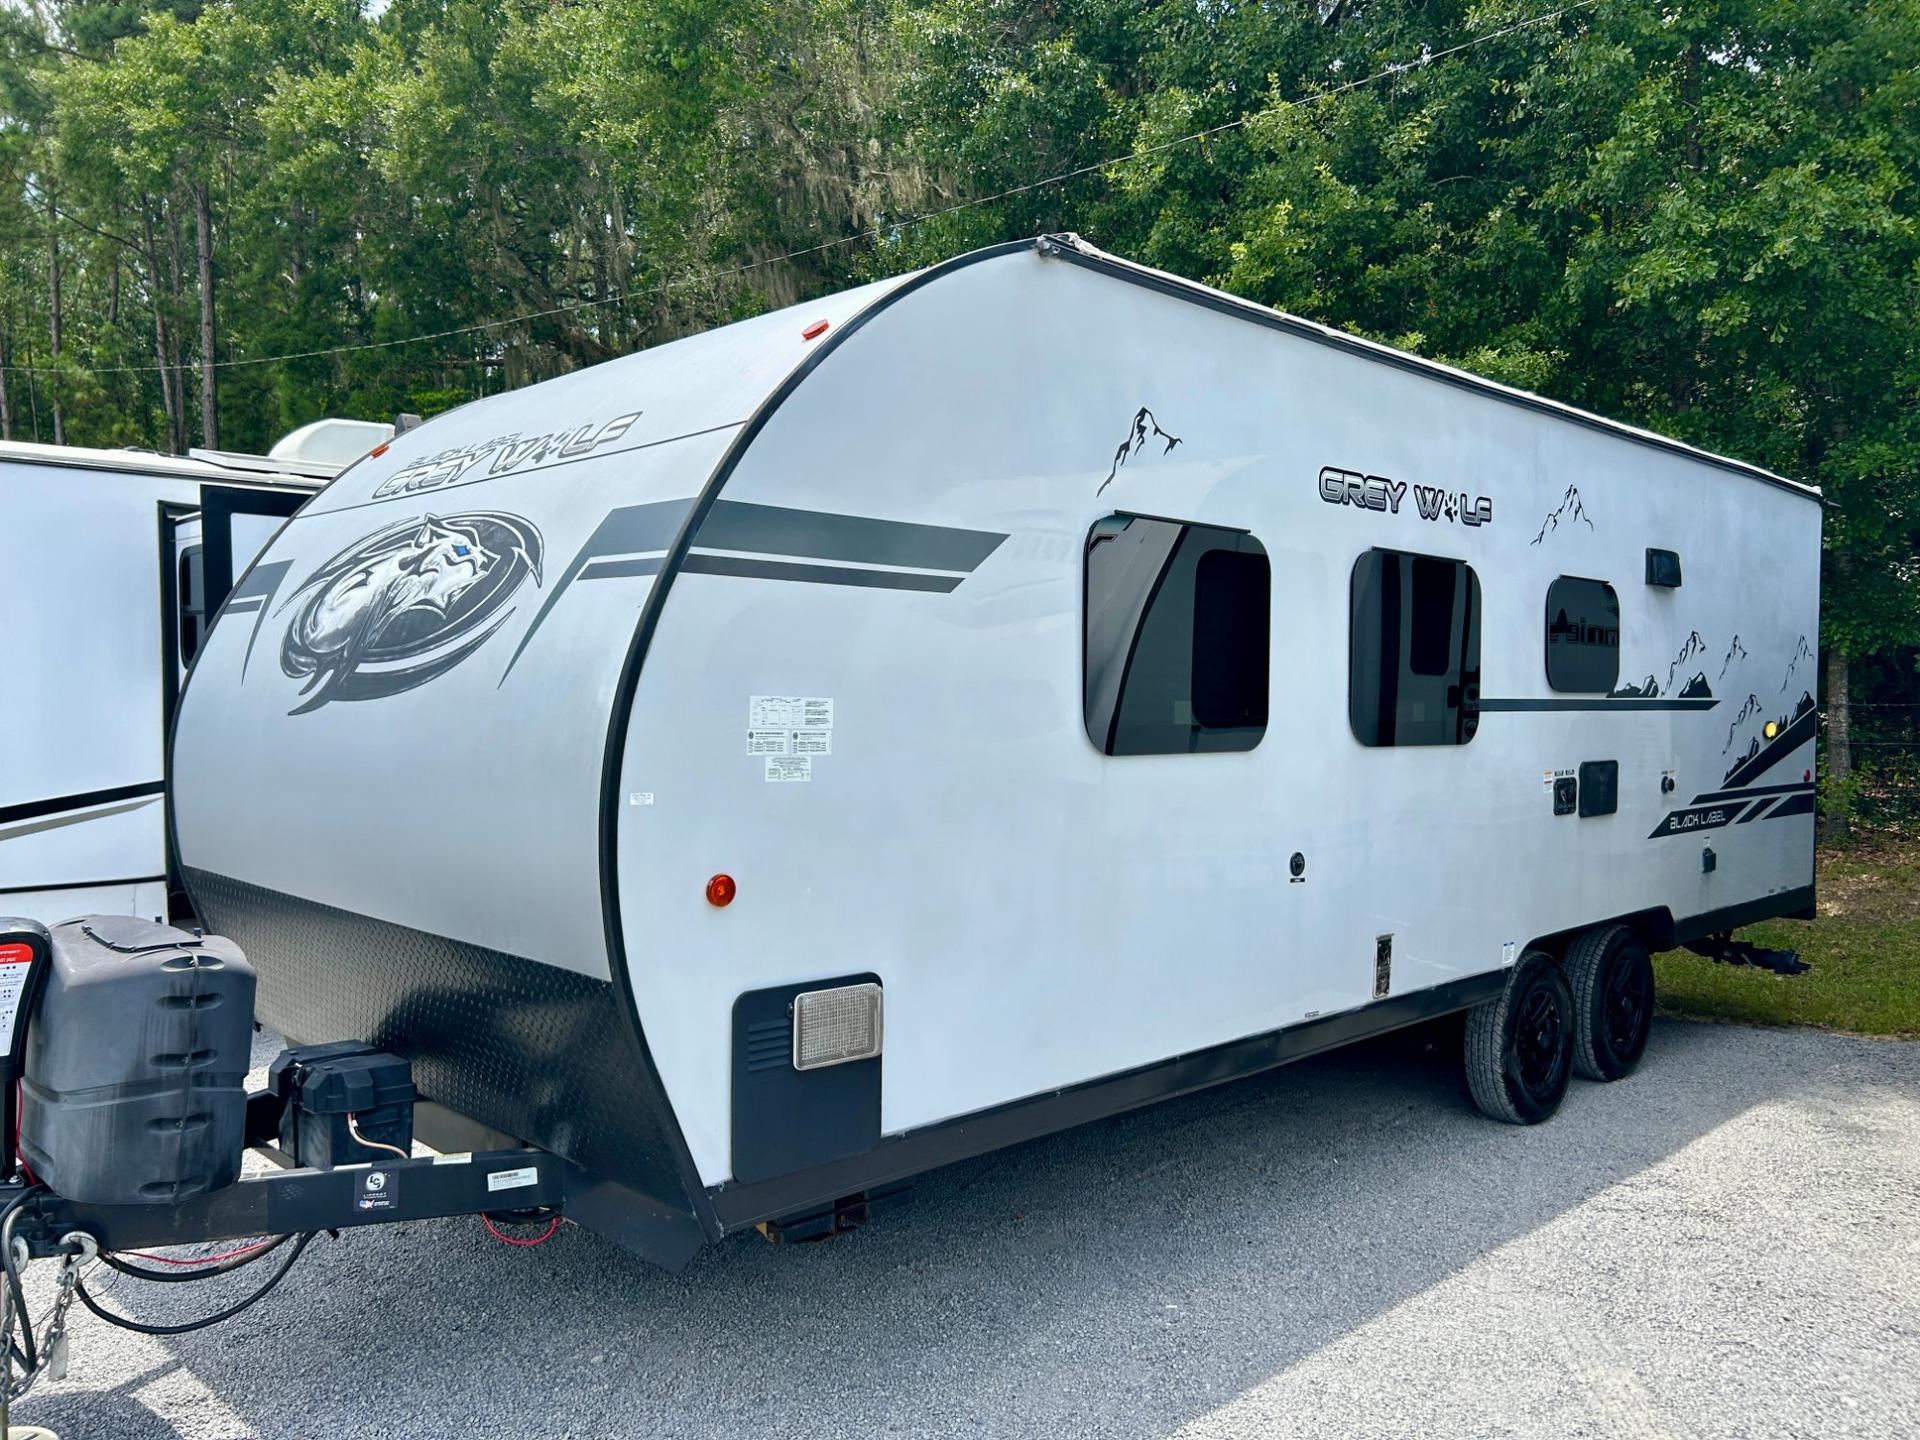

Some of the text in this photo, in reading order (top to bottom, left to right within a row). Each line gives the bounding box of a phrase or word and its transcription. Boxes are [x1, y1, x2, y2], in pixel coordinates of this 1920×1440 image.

[372, 450, 497, 499] GREY
[1319, 466, 1407, 514] GREY
[1669, 810, 1726, 830] BLACK LABEL
